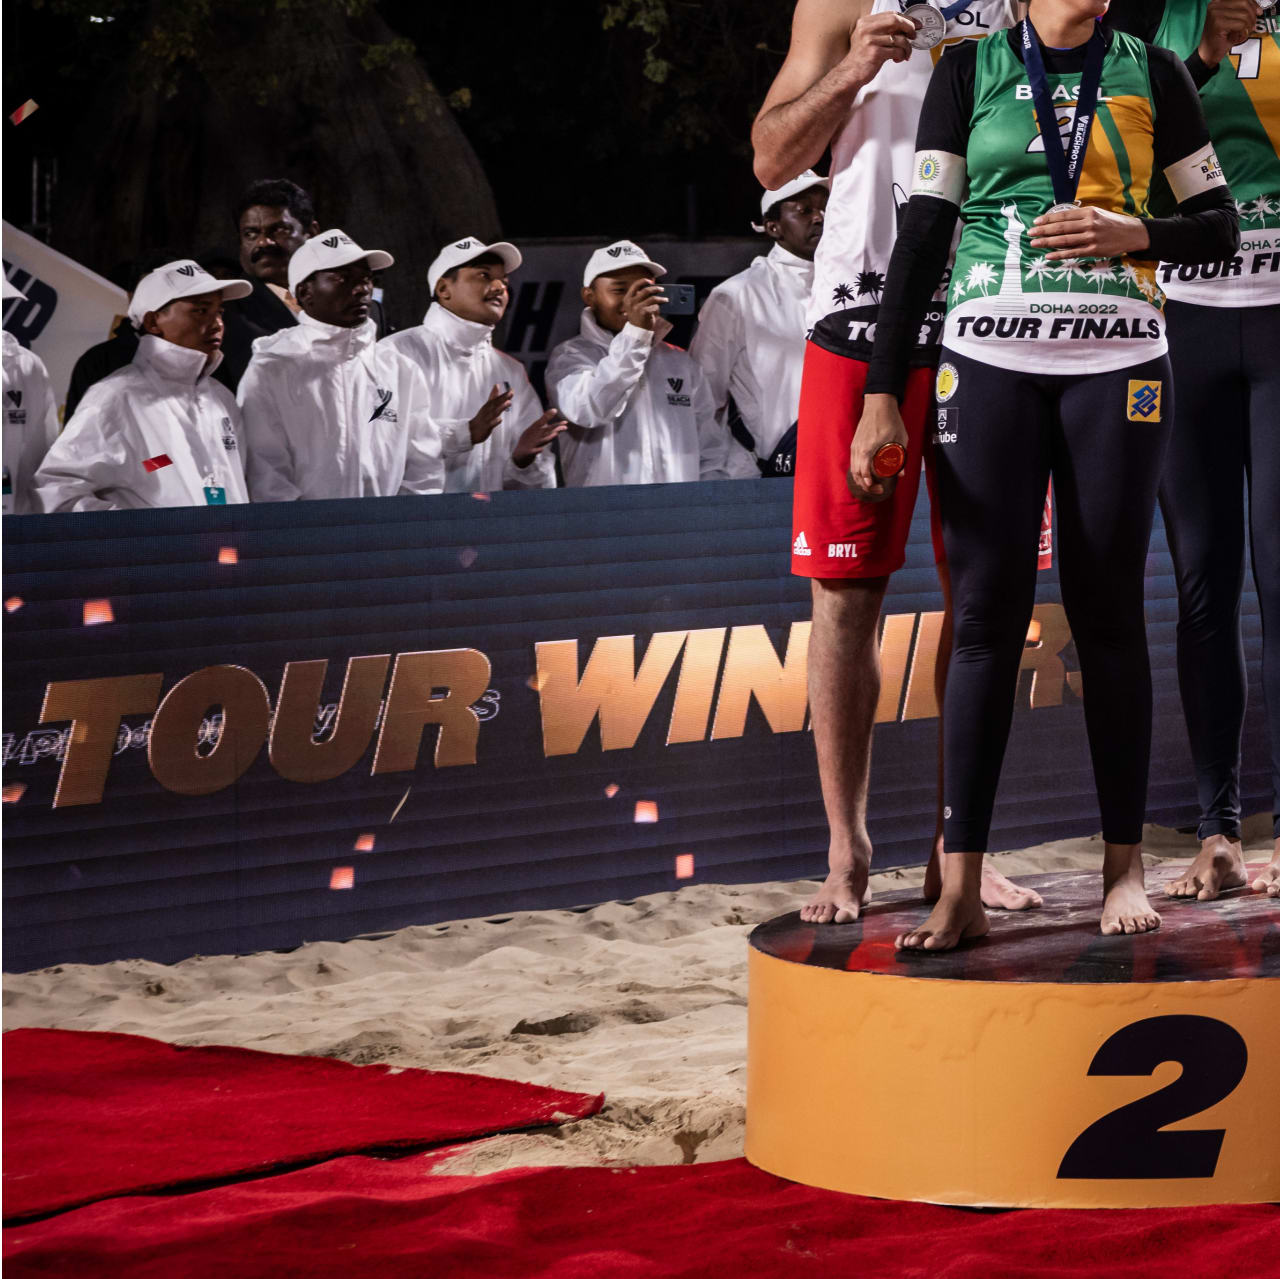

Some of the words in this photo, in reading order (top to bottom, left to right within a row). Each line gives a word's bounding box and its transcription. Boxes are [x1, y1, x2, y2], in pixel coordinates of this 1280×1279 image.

[955, 10, 990, 28] OL
[1229, 38, 1262, 80] 1
[1015, 84, 1113, 101] BASL
[1074, 123, 1086, 148] BEACH
[1070, 147, 1081, 161] PRO
[1067, 161, 1078, 180] TOUR
[1206, 169, 1222, 182] ATLE
[1160, 254, 1245, 284] TOUR
[1029, 303, 1075, 315] DOHA
[1077, 303, 1119, 315] 2022
[956, 316, 1041, 340] TOUR
[1047, 316, 1161, 340] FINALS
[827, 543, 858, 558] BRYL
[39, 647, 492, 810] TOUR
[1057, 1015, 1247, 1179] 2
